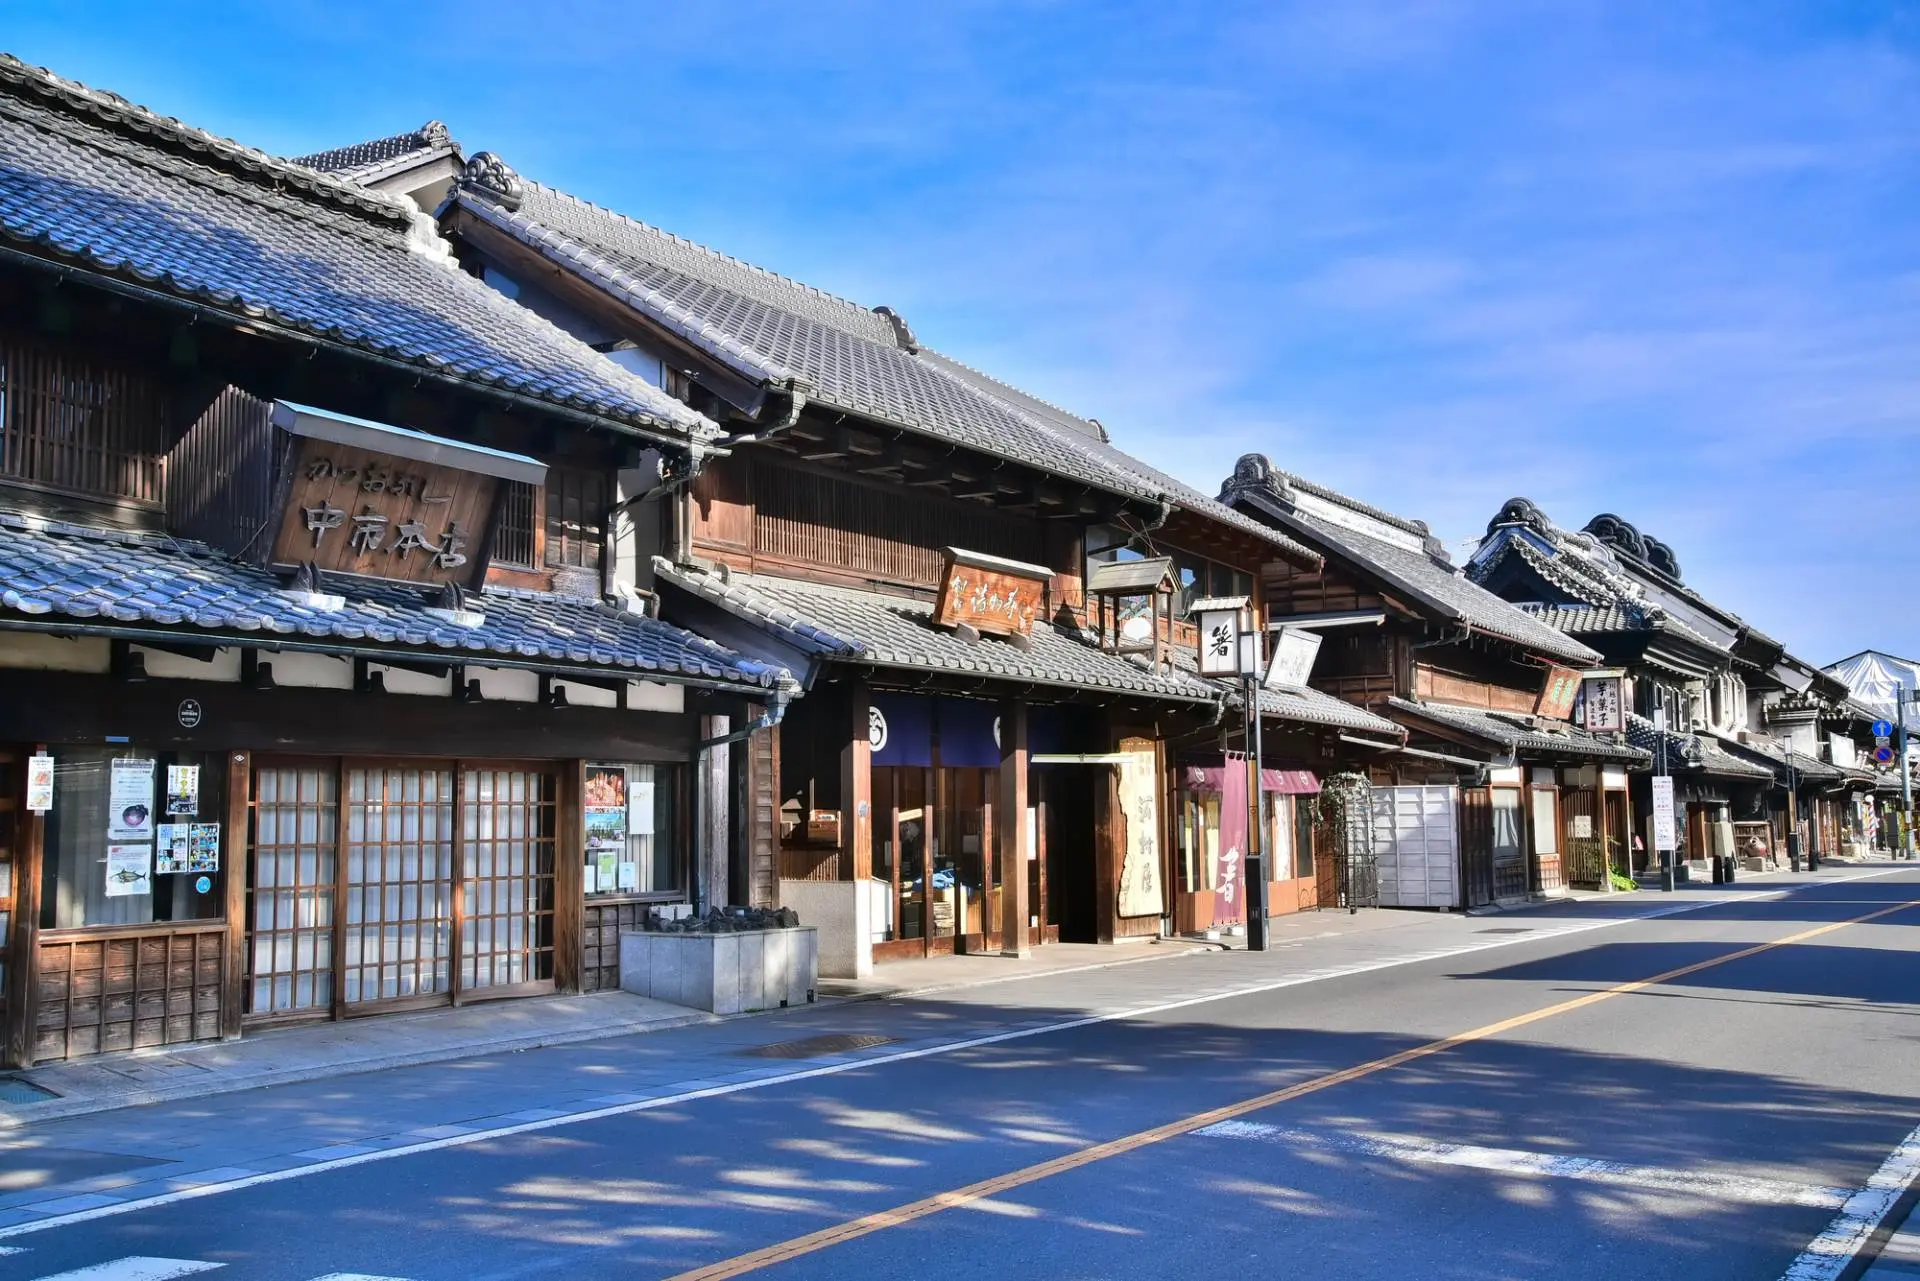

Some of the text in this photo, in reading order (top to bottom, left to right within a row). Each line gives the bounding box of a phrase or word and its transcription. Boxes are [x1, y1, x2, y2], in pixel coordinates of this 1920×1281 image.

[307, 459, 452, 504] かつおぶし
[303, 500, 468, 569] 中市本店
[1209, 624, 1233, 656] 箸
[1596, 681, 1609, 727] 芋菓子
